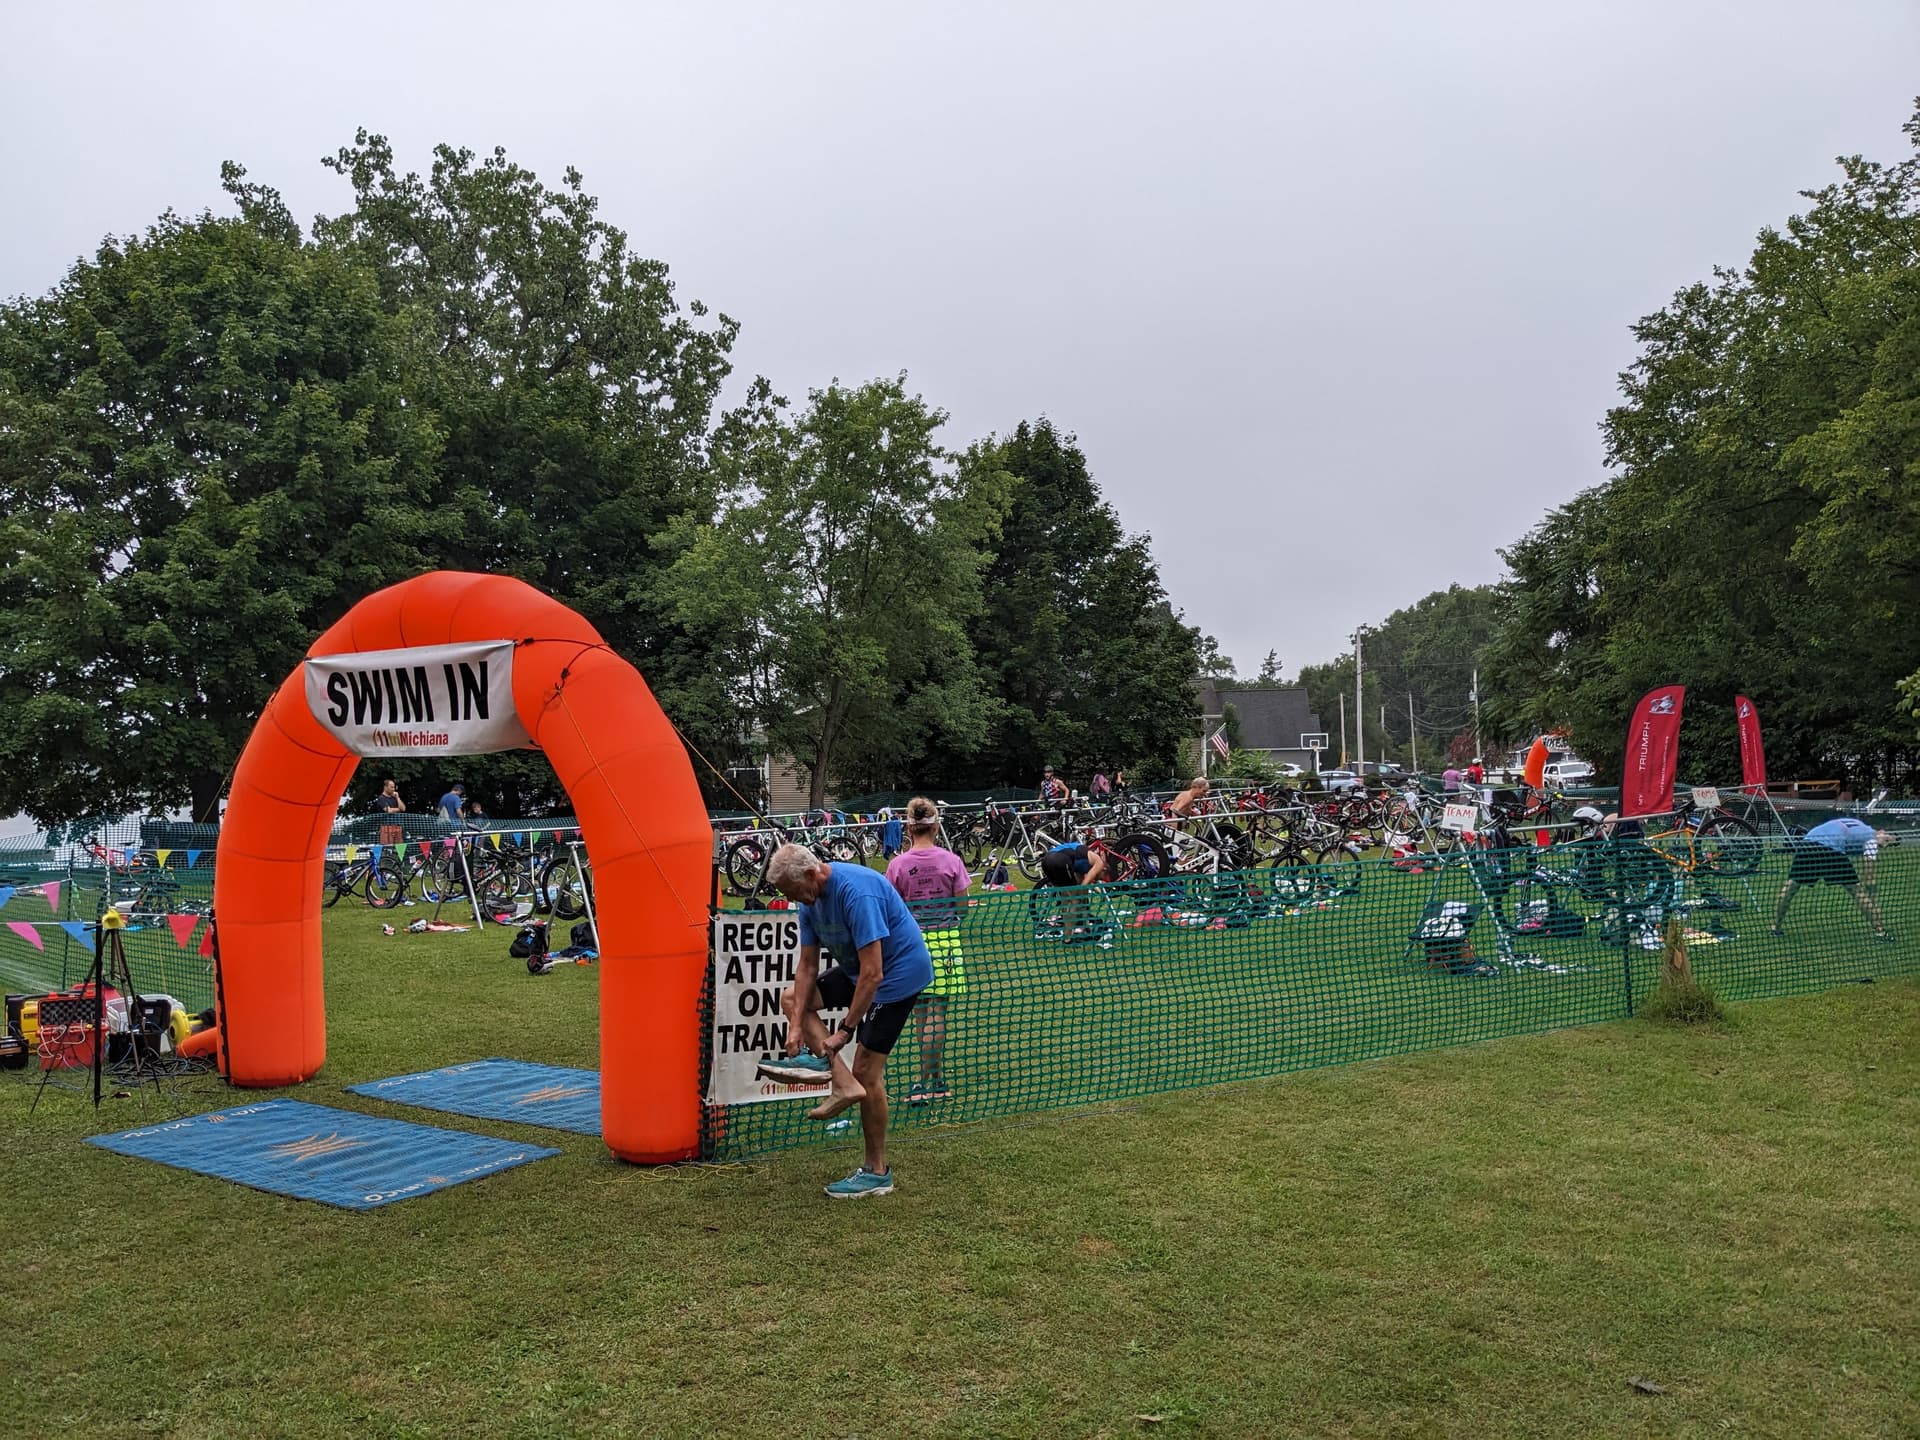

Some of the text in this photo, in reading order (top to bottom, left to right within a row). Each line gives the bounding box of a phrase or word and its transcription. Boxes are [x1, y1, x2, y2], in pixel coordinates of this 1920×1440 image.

[327, 661, 489, 727] SWIM IN
[1638, 720, 1651, 772] TRIUMPH
[1638, 793, 1645, 806] MY
[722, 922, 798, 952] REGIS
